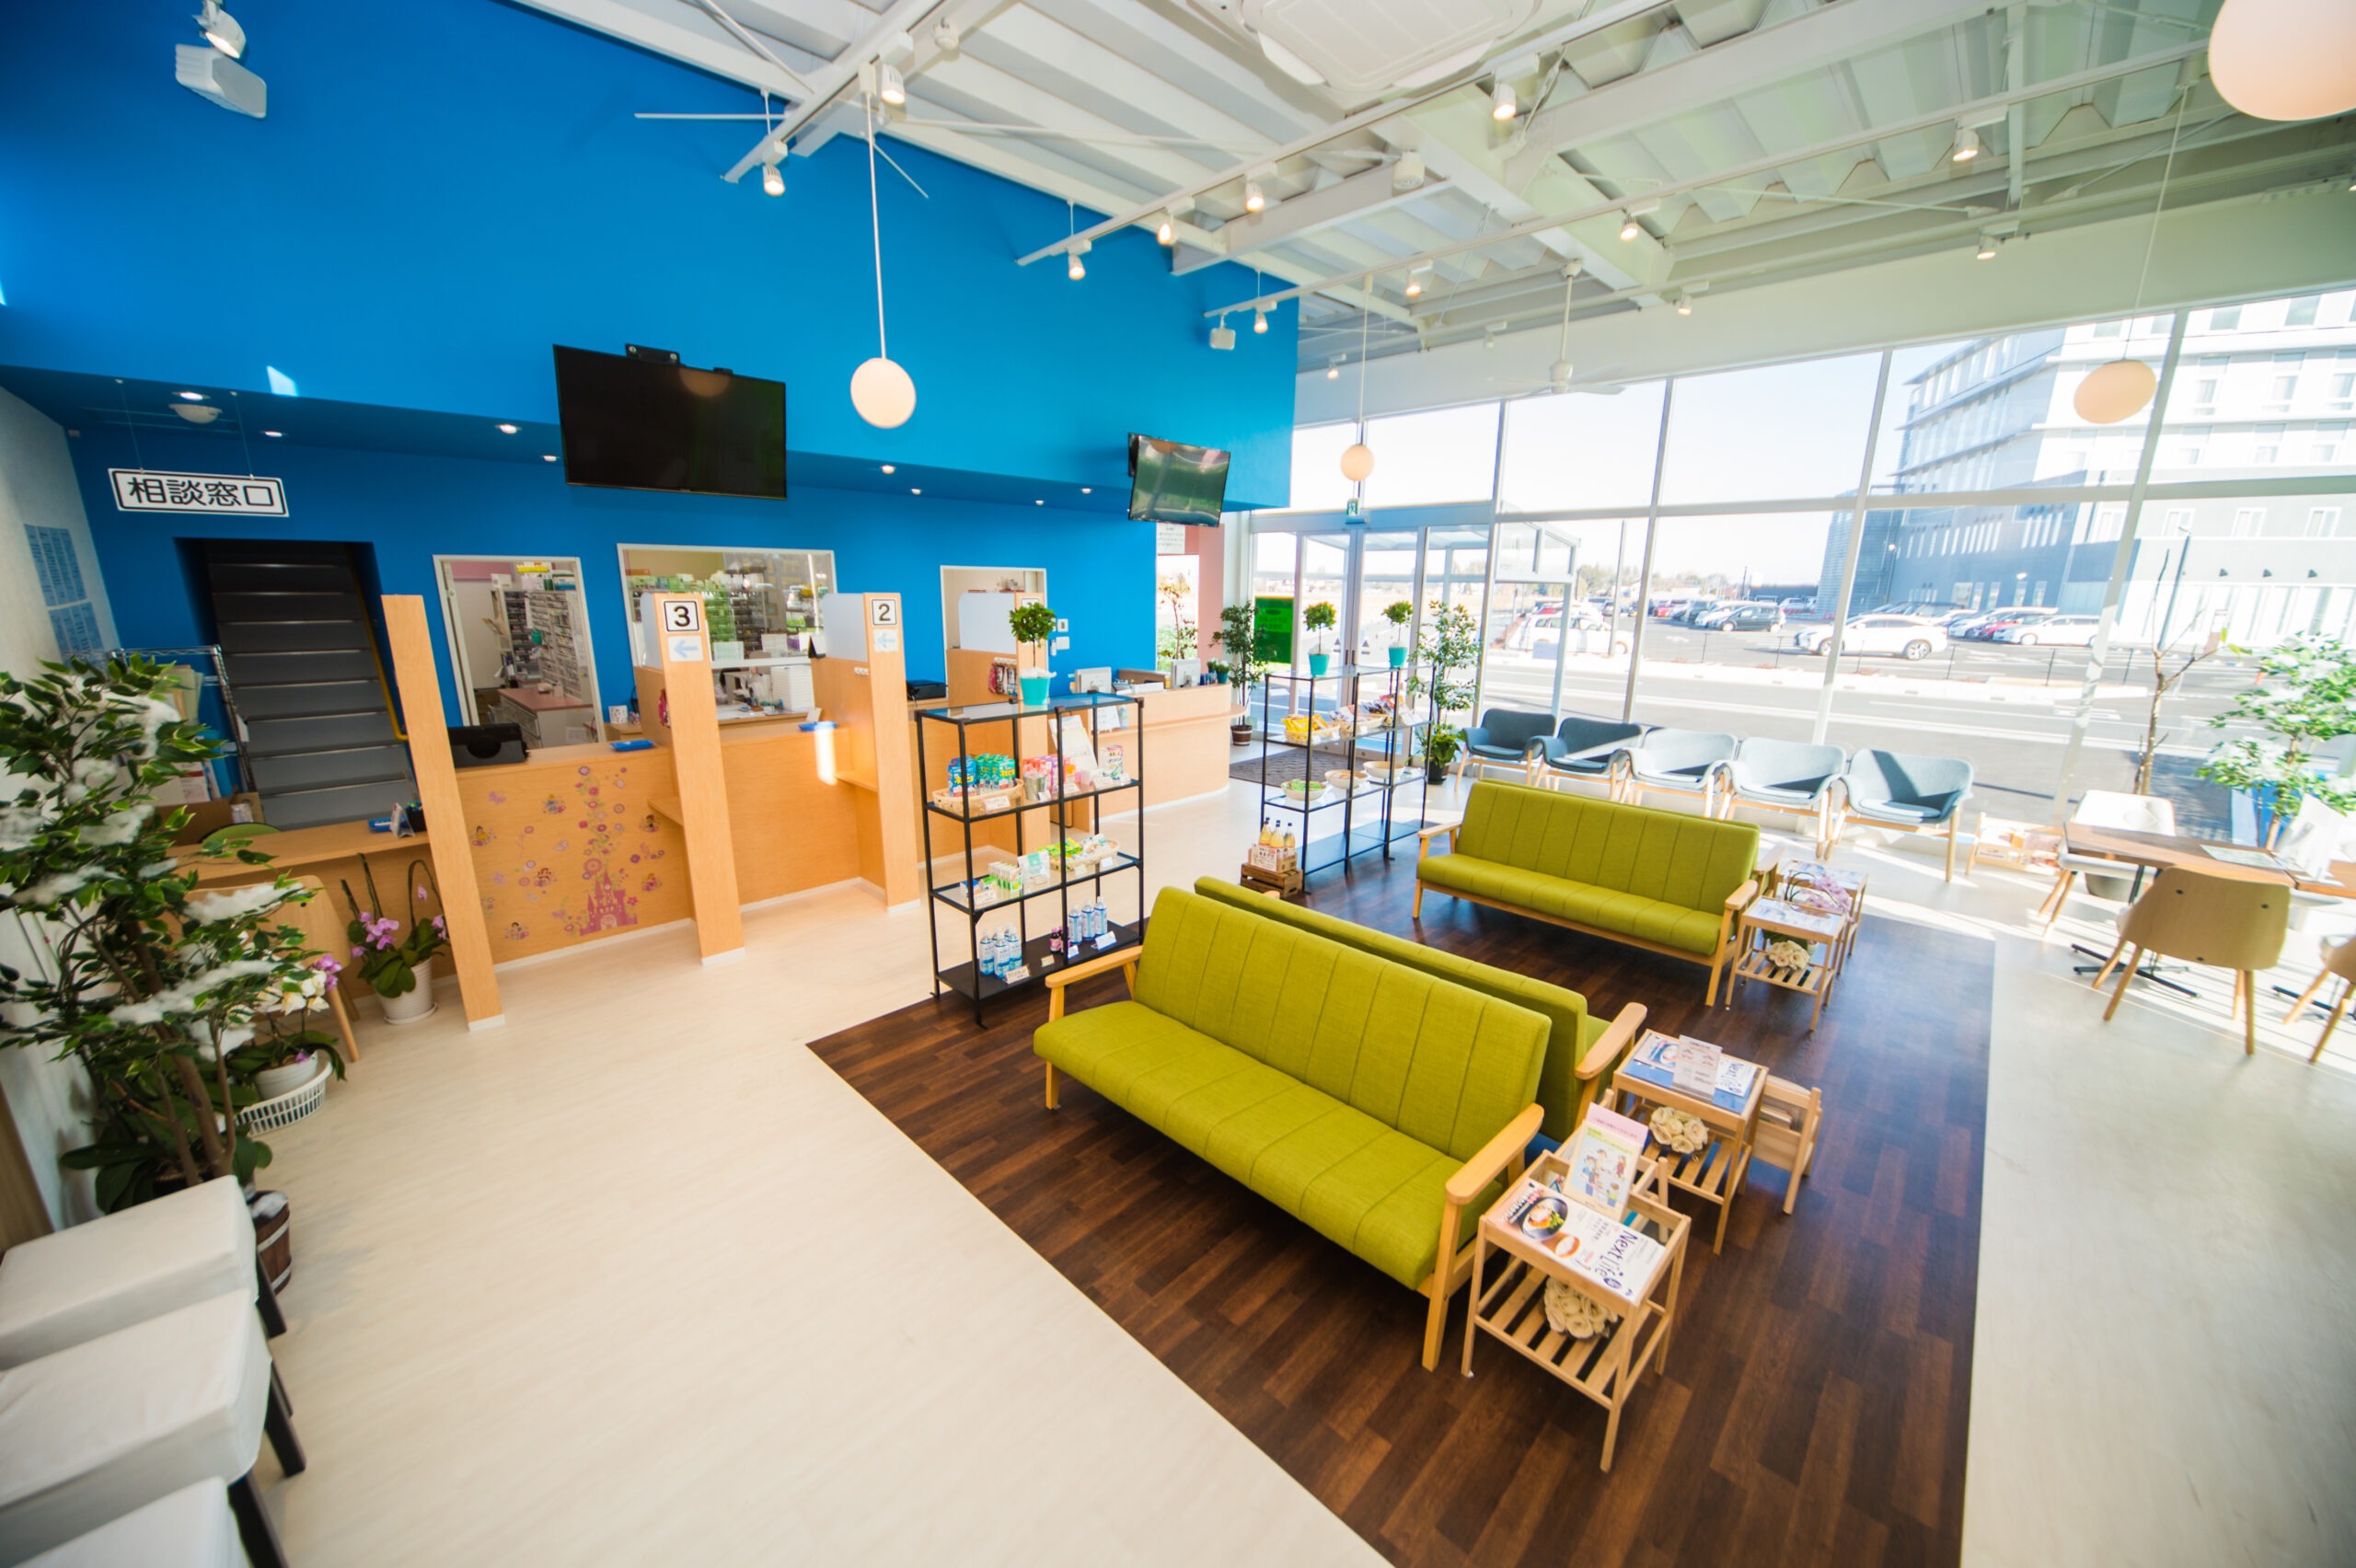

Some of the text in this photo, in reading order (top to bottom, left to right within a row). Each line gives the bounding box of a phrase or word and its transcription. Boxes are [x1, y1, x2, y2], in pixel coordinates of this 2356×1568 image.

[127, 477, 274, 506] 相談窓口
[673, 605, 690, 627] 3
[878, 604, 891, 621] 2
[1607, 1229, 1638, 1261] Next
